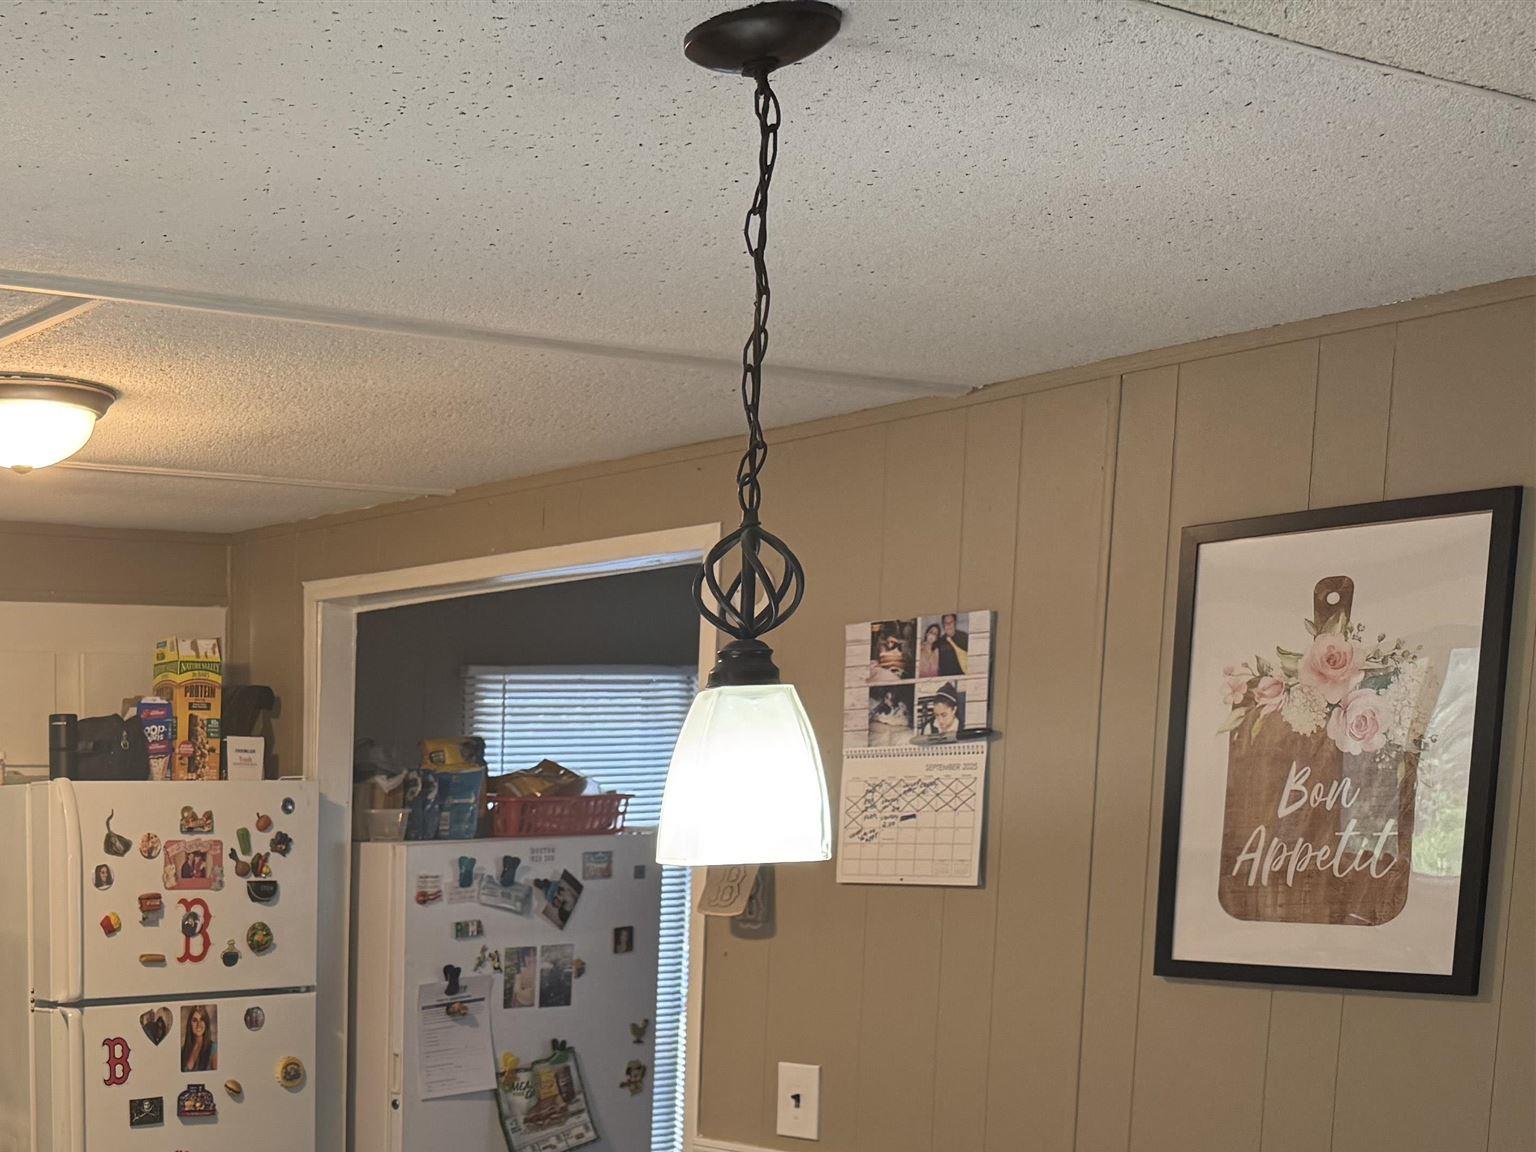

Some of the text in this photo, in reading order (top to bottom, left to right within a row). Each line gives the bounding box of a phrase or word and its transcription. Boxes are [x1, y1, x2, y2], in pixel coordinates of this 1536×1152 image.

[184, 685, 216, 698] PROTEIN
[1277, 760, 1360, 819] Bon
[1231, 818, 1400, 888] Appetit
[102, 1037, 132, 1087] B
